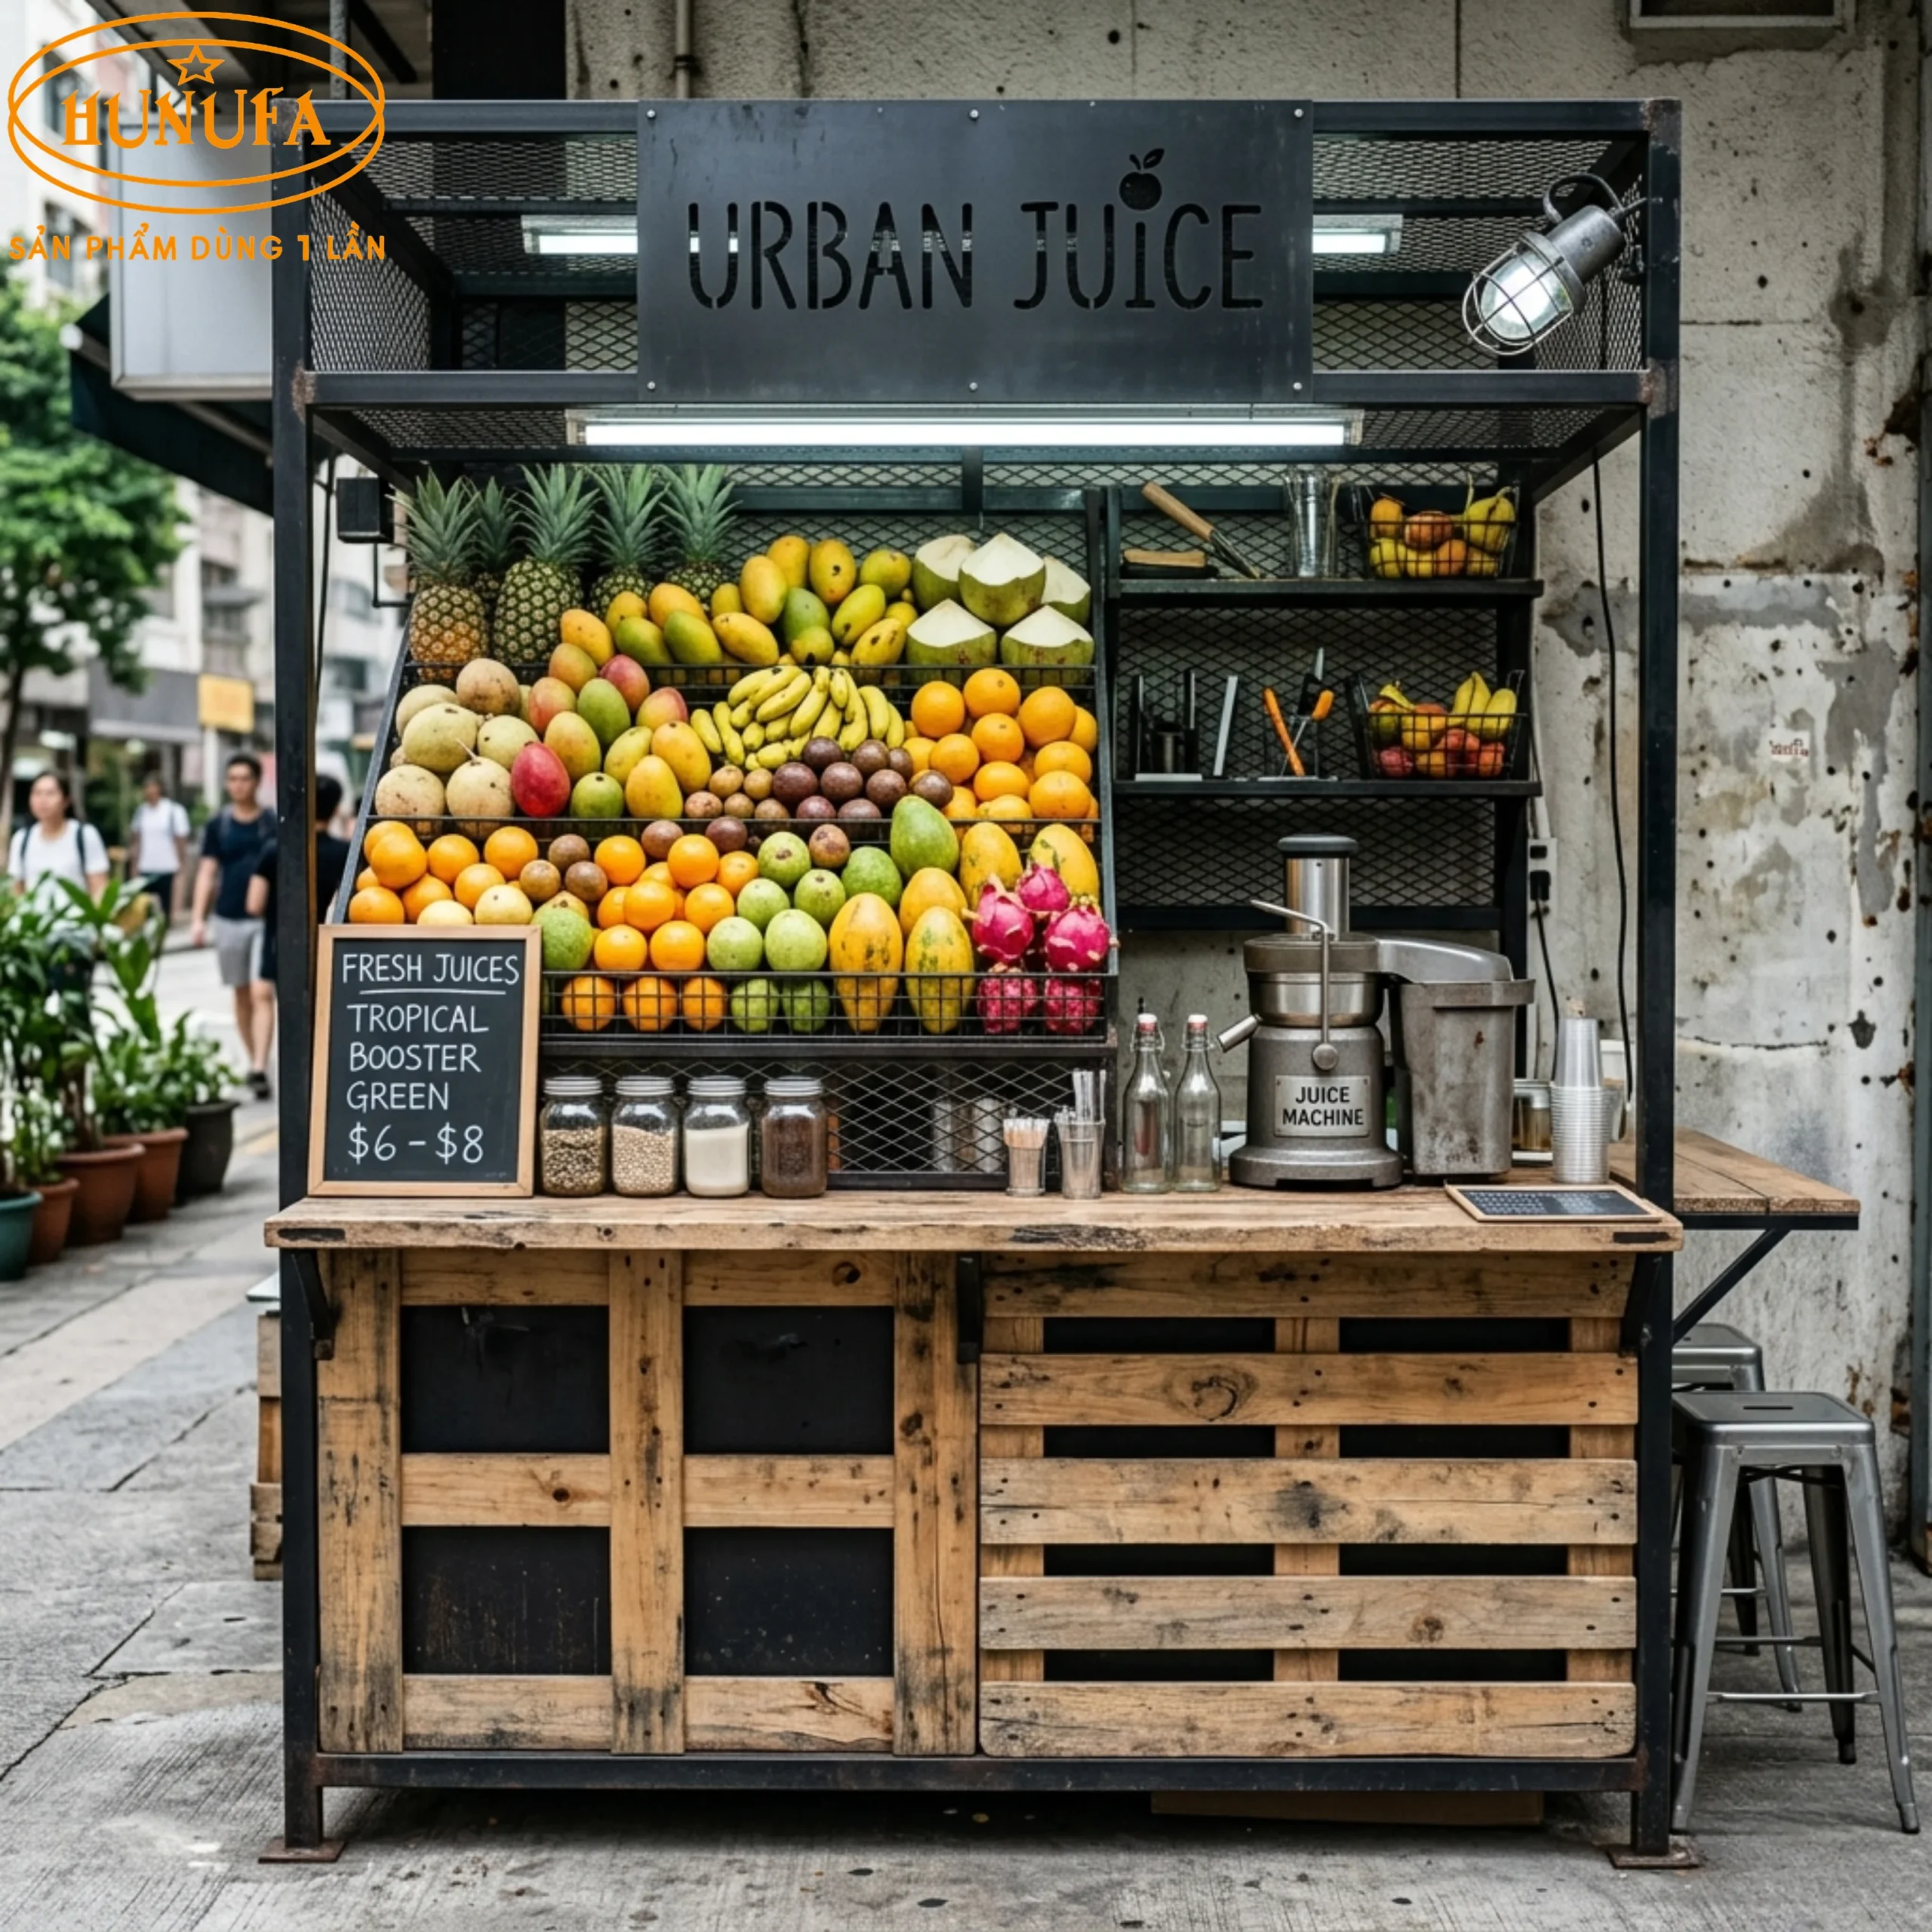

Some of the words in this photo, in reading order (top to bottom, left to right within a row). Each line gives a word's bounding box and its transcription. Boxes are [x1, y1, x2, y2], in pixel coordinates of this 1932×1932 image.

[687, 200, 974, 311] URBAN
[343, 953, 422, 983] FRESH
[433, 954, 519, 985] JUICES
[346, 1004, 489, 1033] TROPICAL
[349, 1041, 481, 1072] BOOSTER
[346, 1081, 448, 1113] GREEN
[1296, 1086, 1349, 1103] JUICE
[1282, 1109, 1364, 1126] MACHINE
